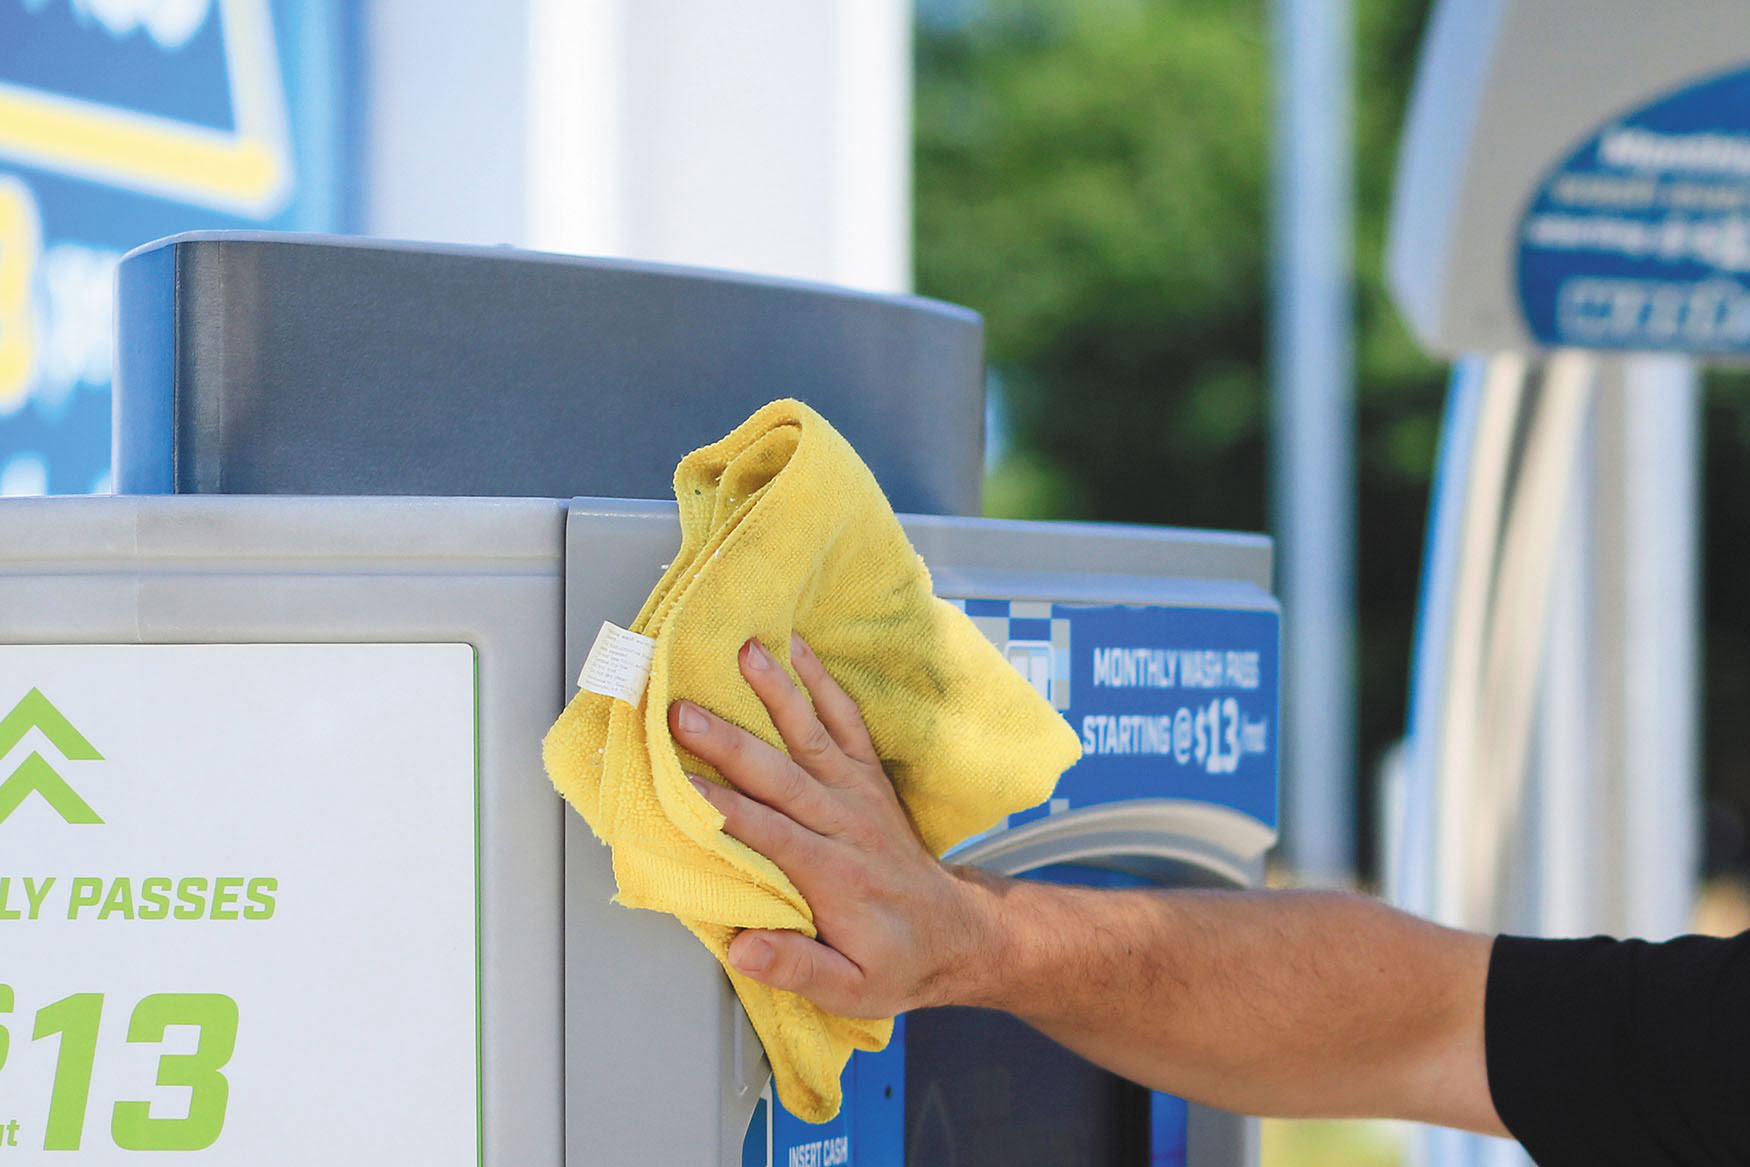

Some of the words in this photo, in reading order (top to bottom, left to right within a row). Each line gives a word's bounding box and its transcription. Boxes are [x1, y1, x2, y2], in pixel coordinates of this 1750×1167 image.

[1093, 648, 1176, 688] MONTHLY
[1082, 714, 1171, 755] STARTING
[67, 877, 279, 921] PASSES
[823, 1135, 849, 1167] CASH
